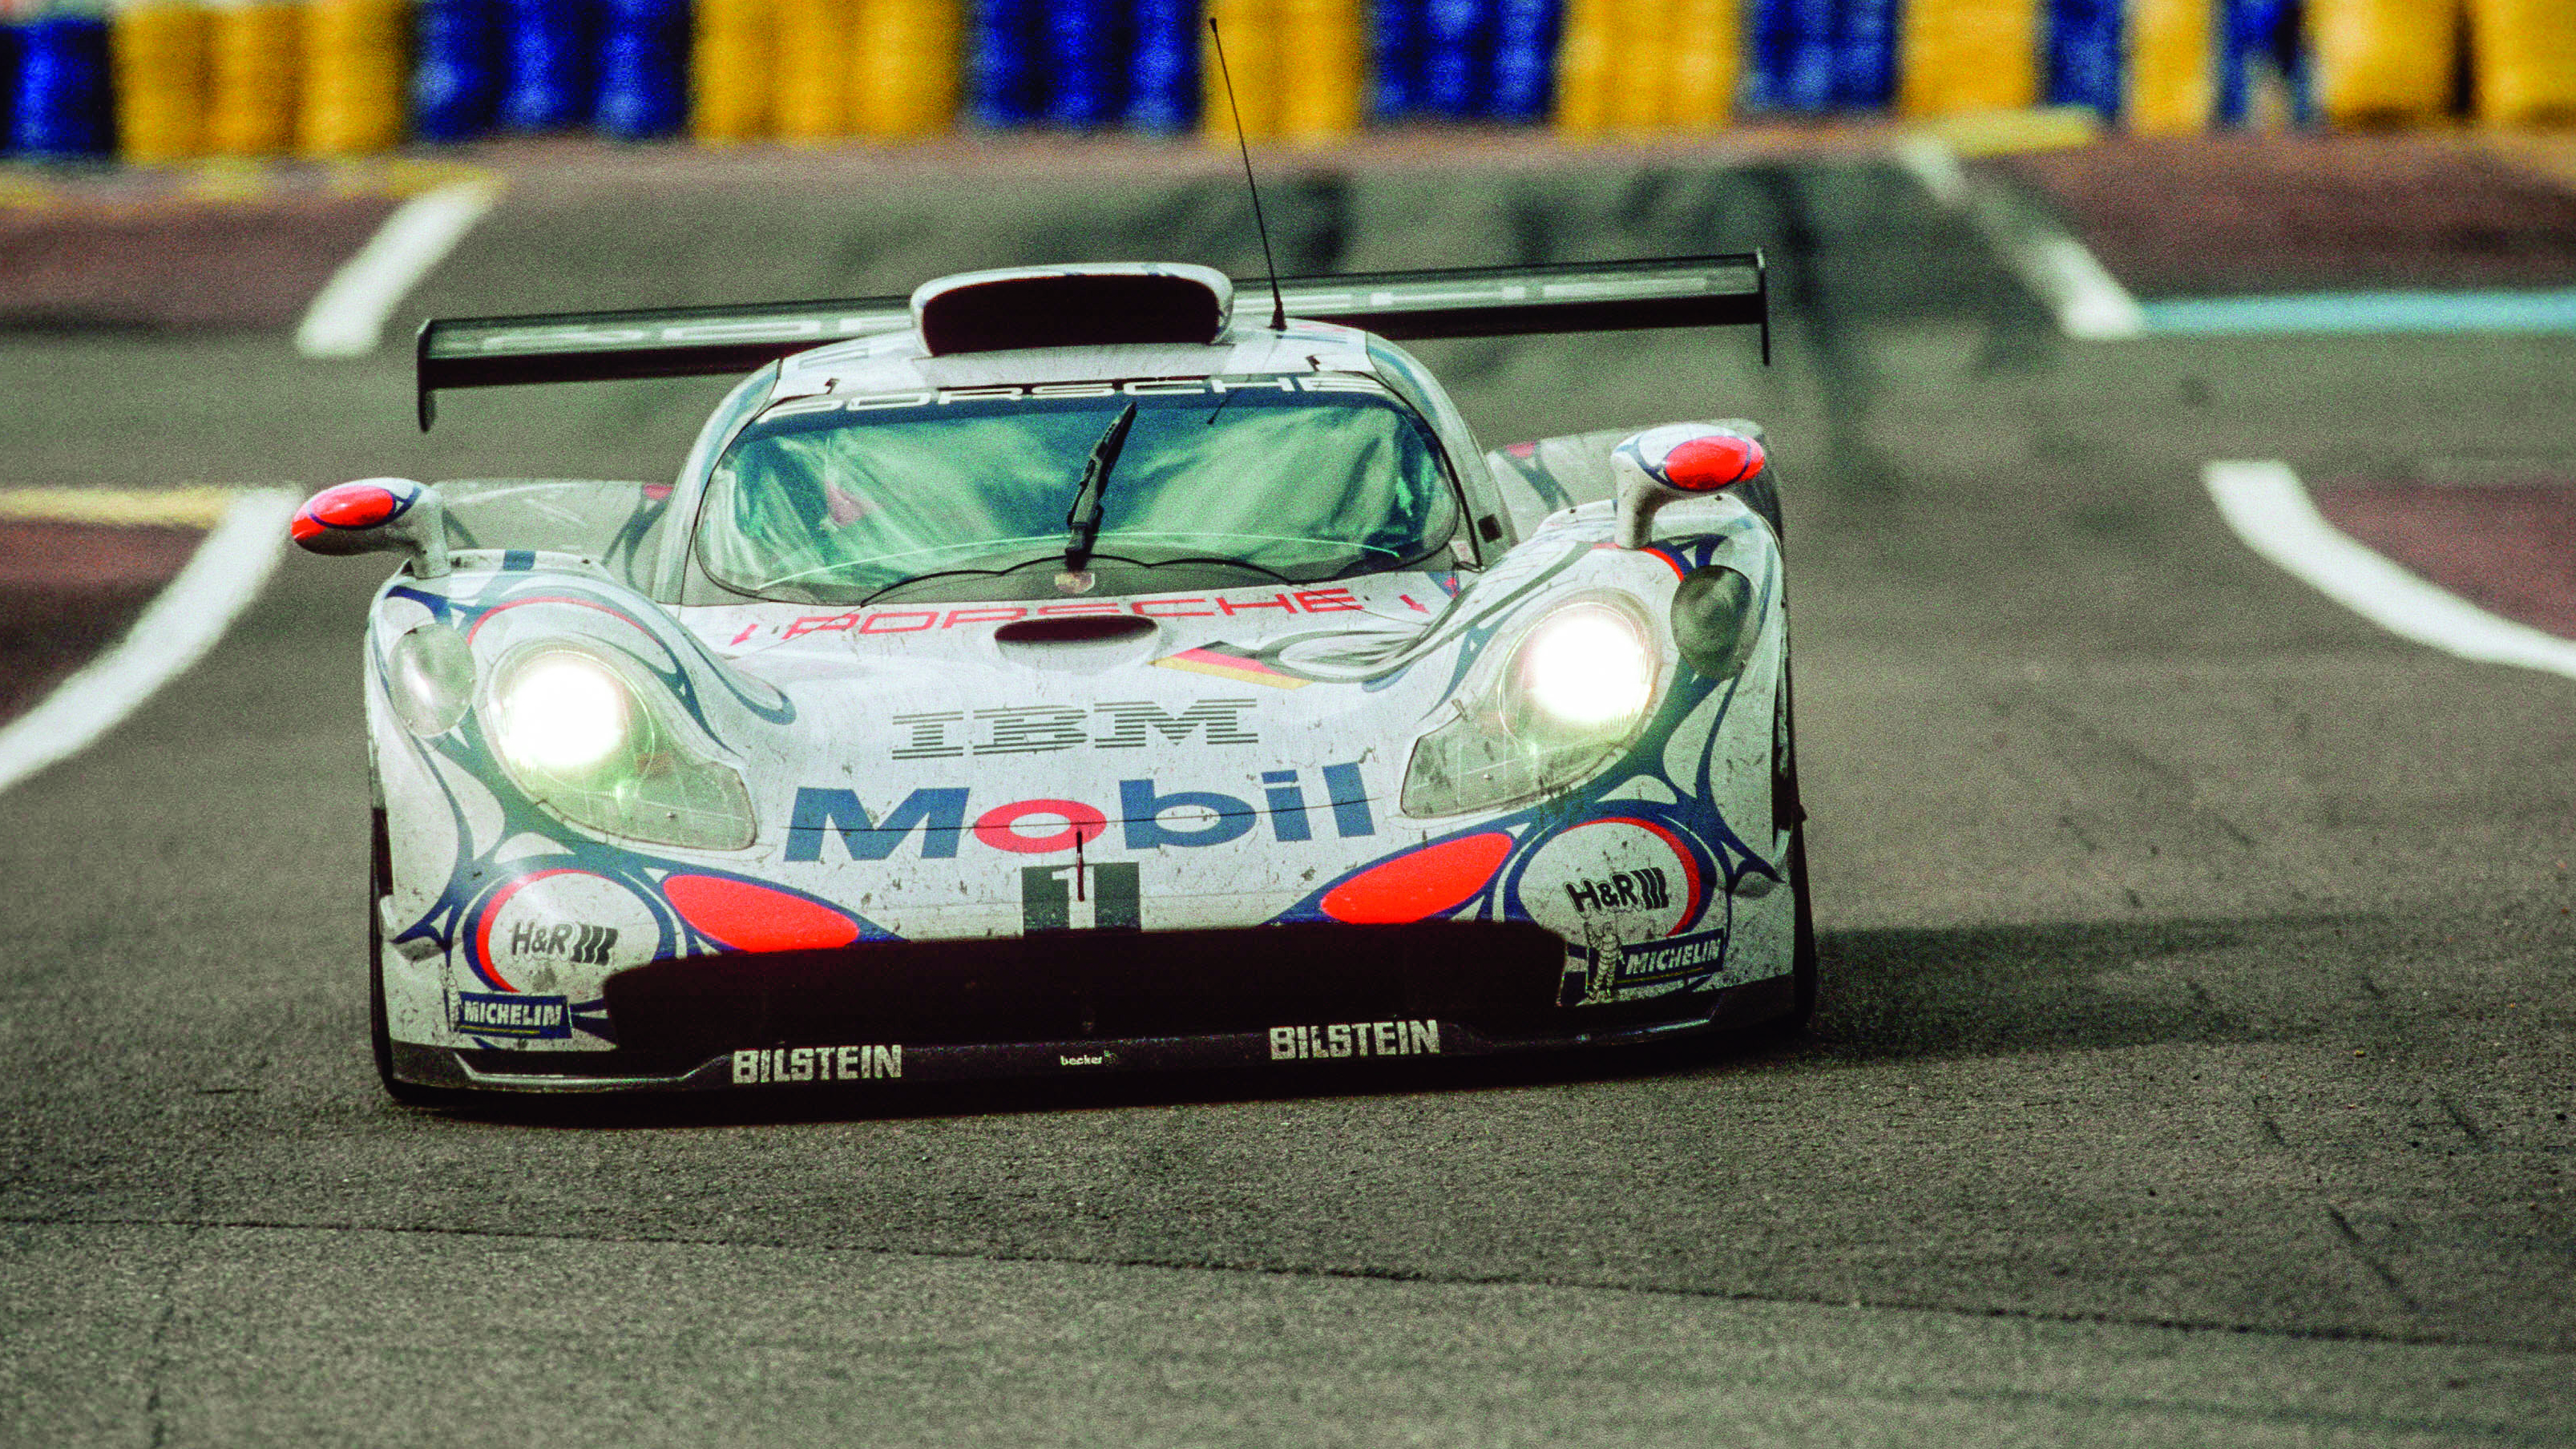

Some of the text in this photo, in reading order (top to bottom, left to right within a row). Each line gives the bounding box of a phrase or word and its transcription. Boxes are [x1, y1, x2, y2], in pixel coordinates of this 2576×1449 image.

[891, 698, 1259, 761] IBM
[783, 762, 1375, 862] Mobil
[1052, 866, 1095, 930] 1
[1565, 874, 1638, 912] H&R
[511, 921, 571, 956] H&R
[1625, 938, 1722, 975] MICHELIN
[462, 1001, 563, 1027] MICHELIN
[1270, 1019, 1440, 1060] BILSTEIN
[733, 1044, 902, 1084] BILSTEIN
